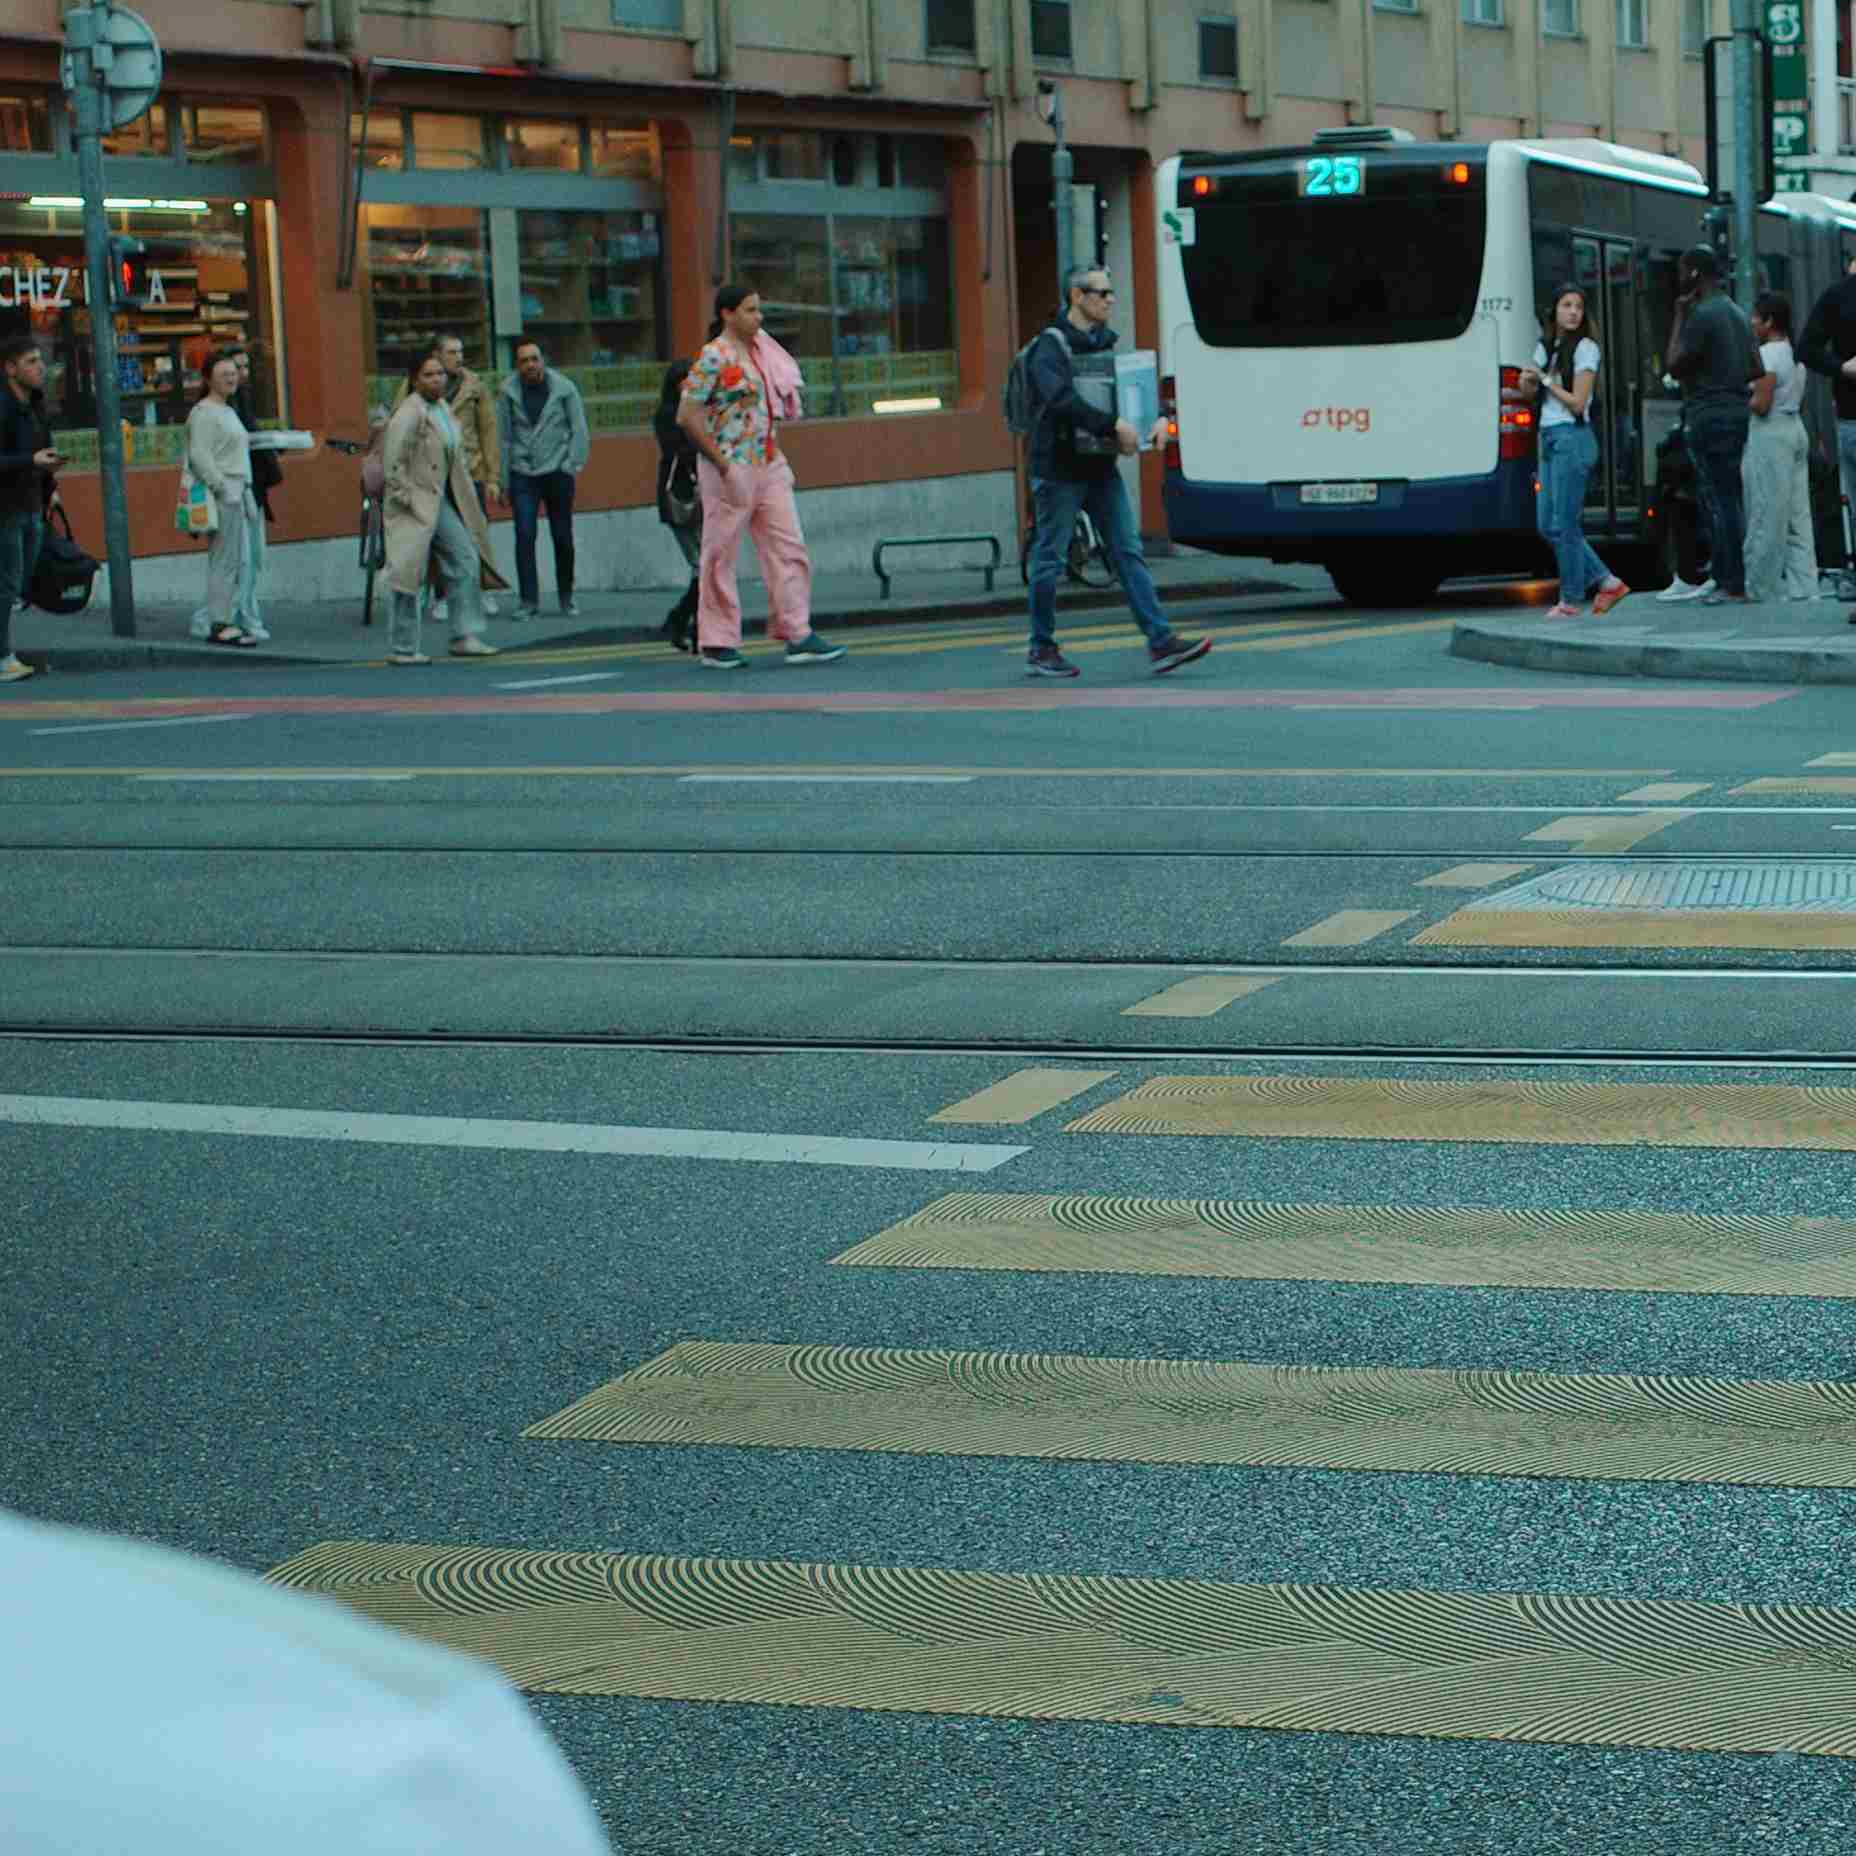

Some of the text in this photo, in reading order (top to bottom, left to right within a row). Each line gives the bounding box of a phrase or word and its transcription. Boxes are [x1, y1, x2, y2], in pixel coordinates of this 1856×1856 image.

[1306, 156, 1361, 195] 25
[0, 266, 71, 307] CHEZ
[1326, 402, 1370, 433] tpg
